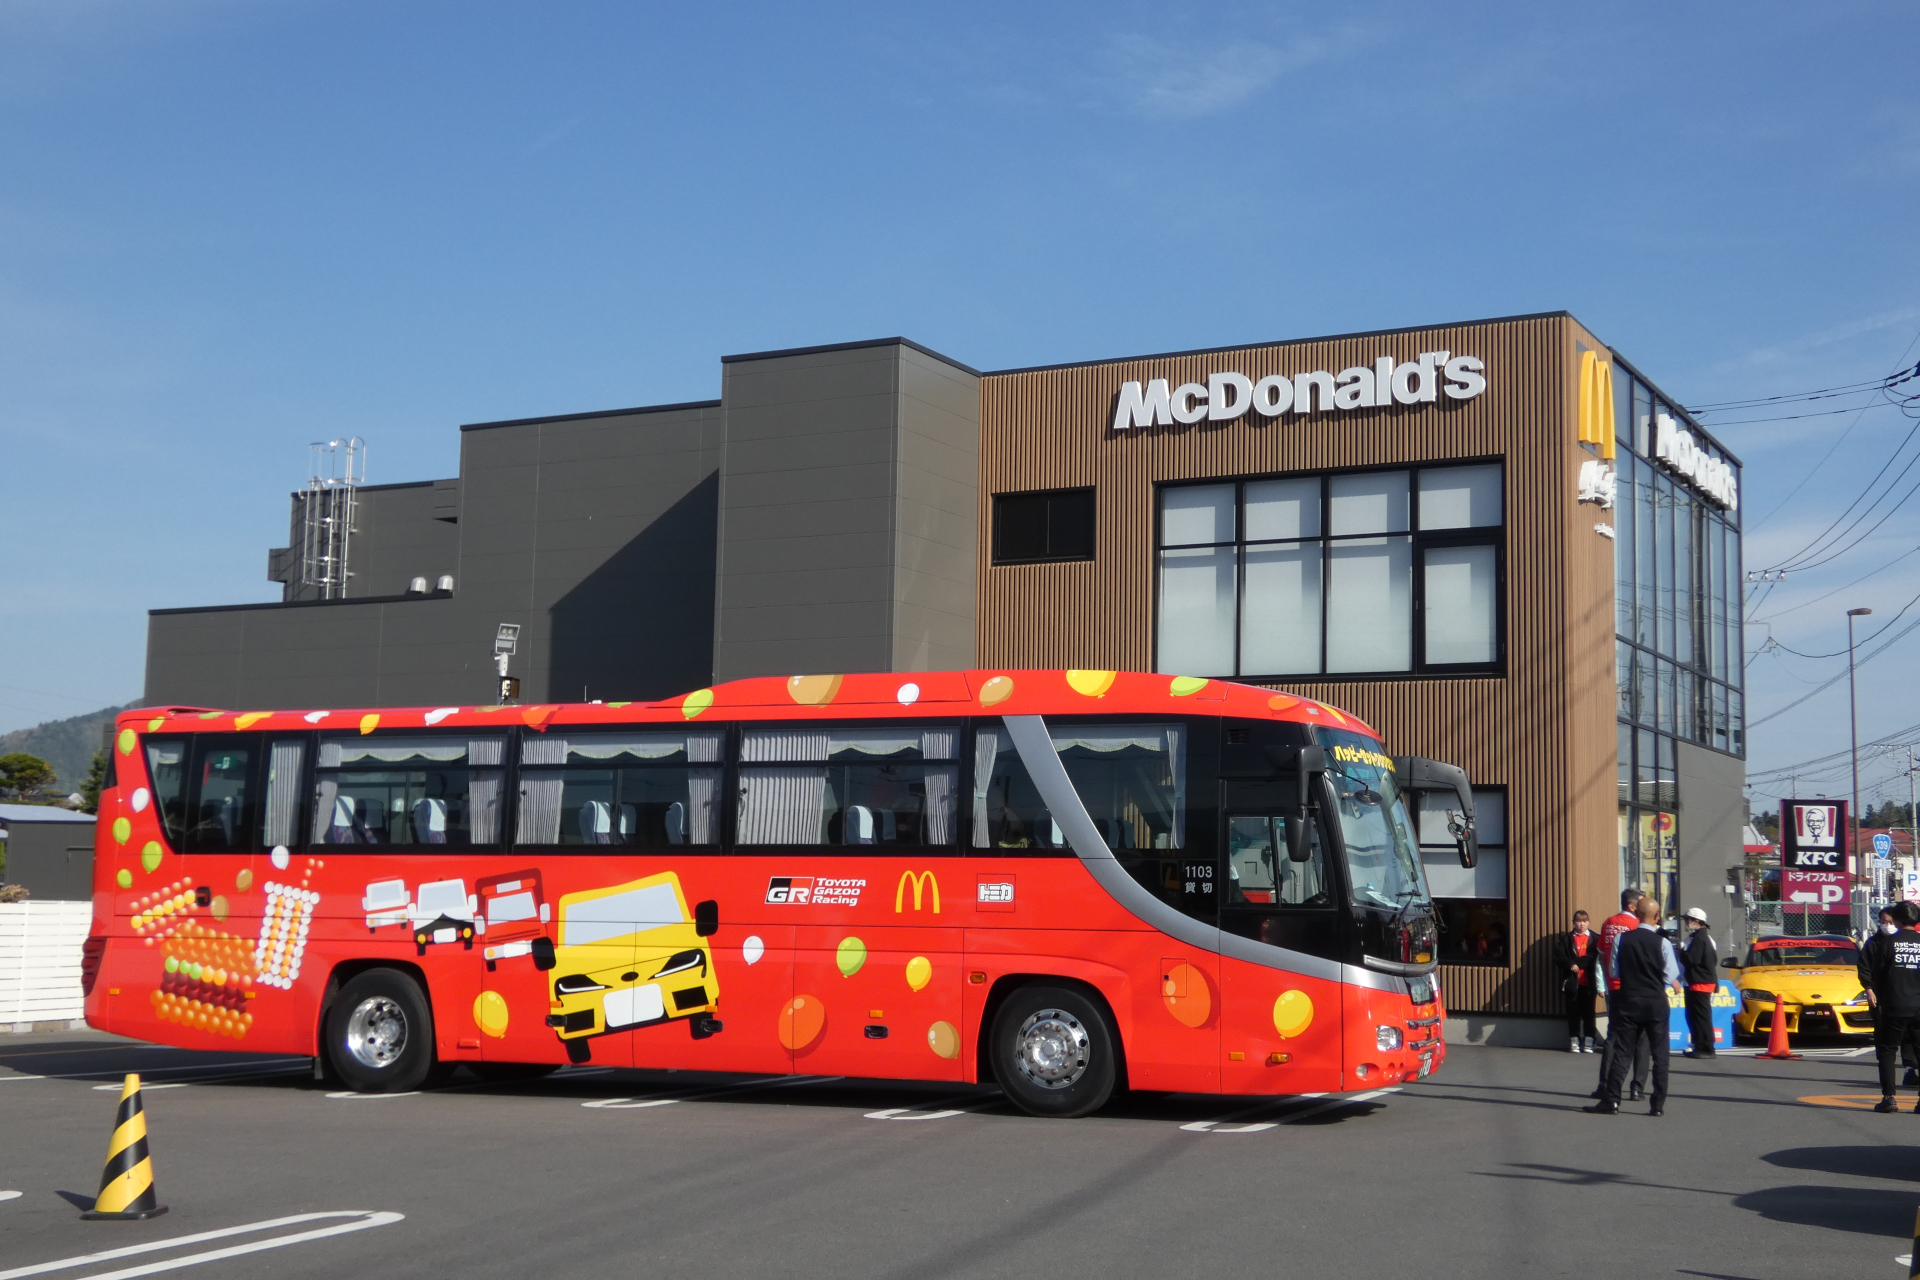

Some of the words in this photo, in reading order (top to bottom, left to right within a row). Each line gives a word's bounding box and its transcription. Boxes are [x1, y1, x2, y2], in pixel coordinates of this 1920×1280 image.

[1114, 350, 1487, 429] McDonald's
[1876, 840, 1888, 850] 139
[1794, 851, 1838, 866] KFC
[1185, 865, 1213, 878] 1103
[816, 877, 867, 887] TOYOTA
[1907, 873, 1918, 885] P
[767, 886, 811, 903] GR
[813, 886, 861, 896] GAZOO
[978, 883, 1014, 902] トミカ
[811, 895, 859, 907] Racing
[1821, 884, 1844, 911] P
[1767, 940, 1841, 948] McDonald's
